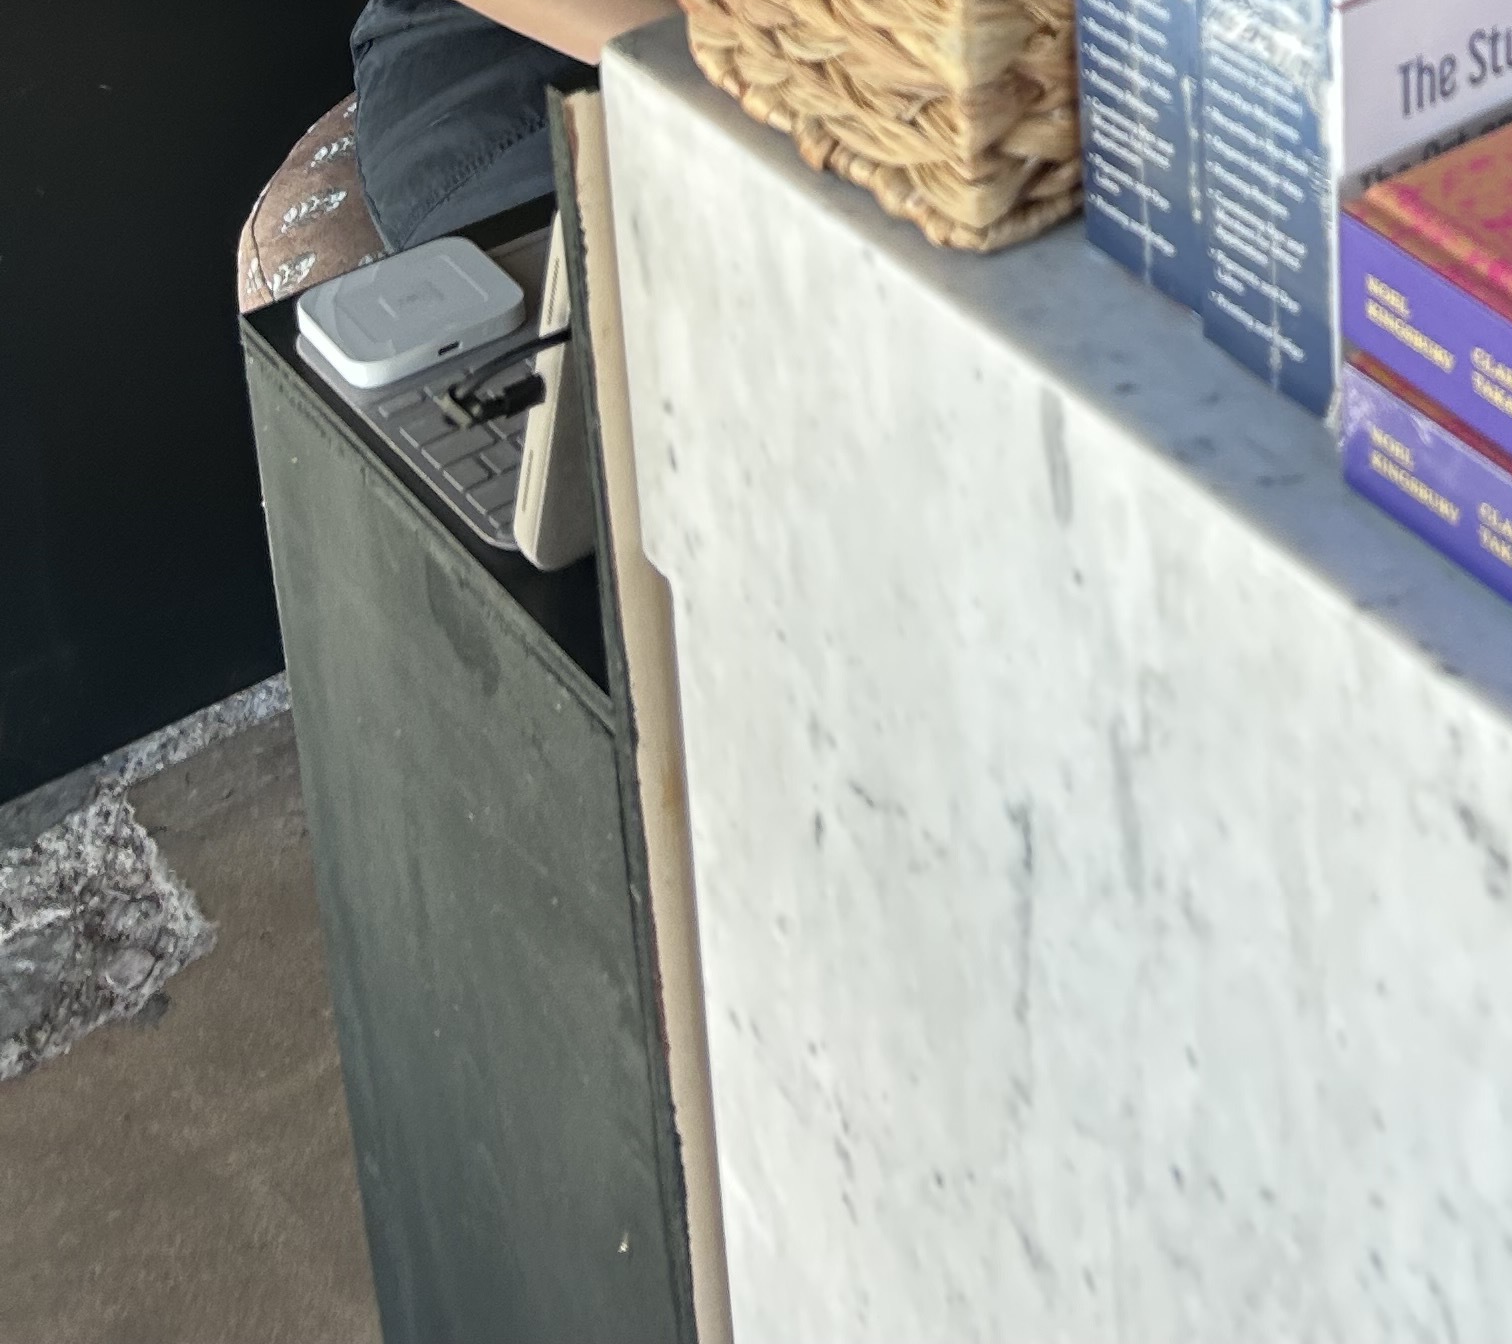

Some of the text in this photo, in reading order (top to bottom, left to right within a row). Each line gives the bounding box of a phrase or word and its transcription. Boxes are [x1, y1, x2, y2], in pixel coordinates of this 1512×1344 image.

[1396, 52, 1459, 119] The
[1365, 273, 1411, 320] NOEL
[1365, 298, 1456, 373] KINGSBURY
[1369, 424, 1415, 469] NOEL
[1370, 449, 1461, 525] KINGSBURY
